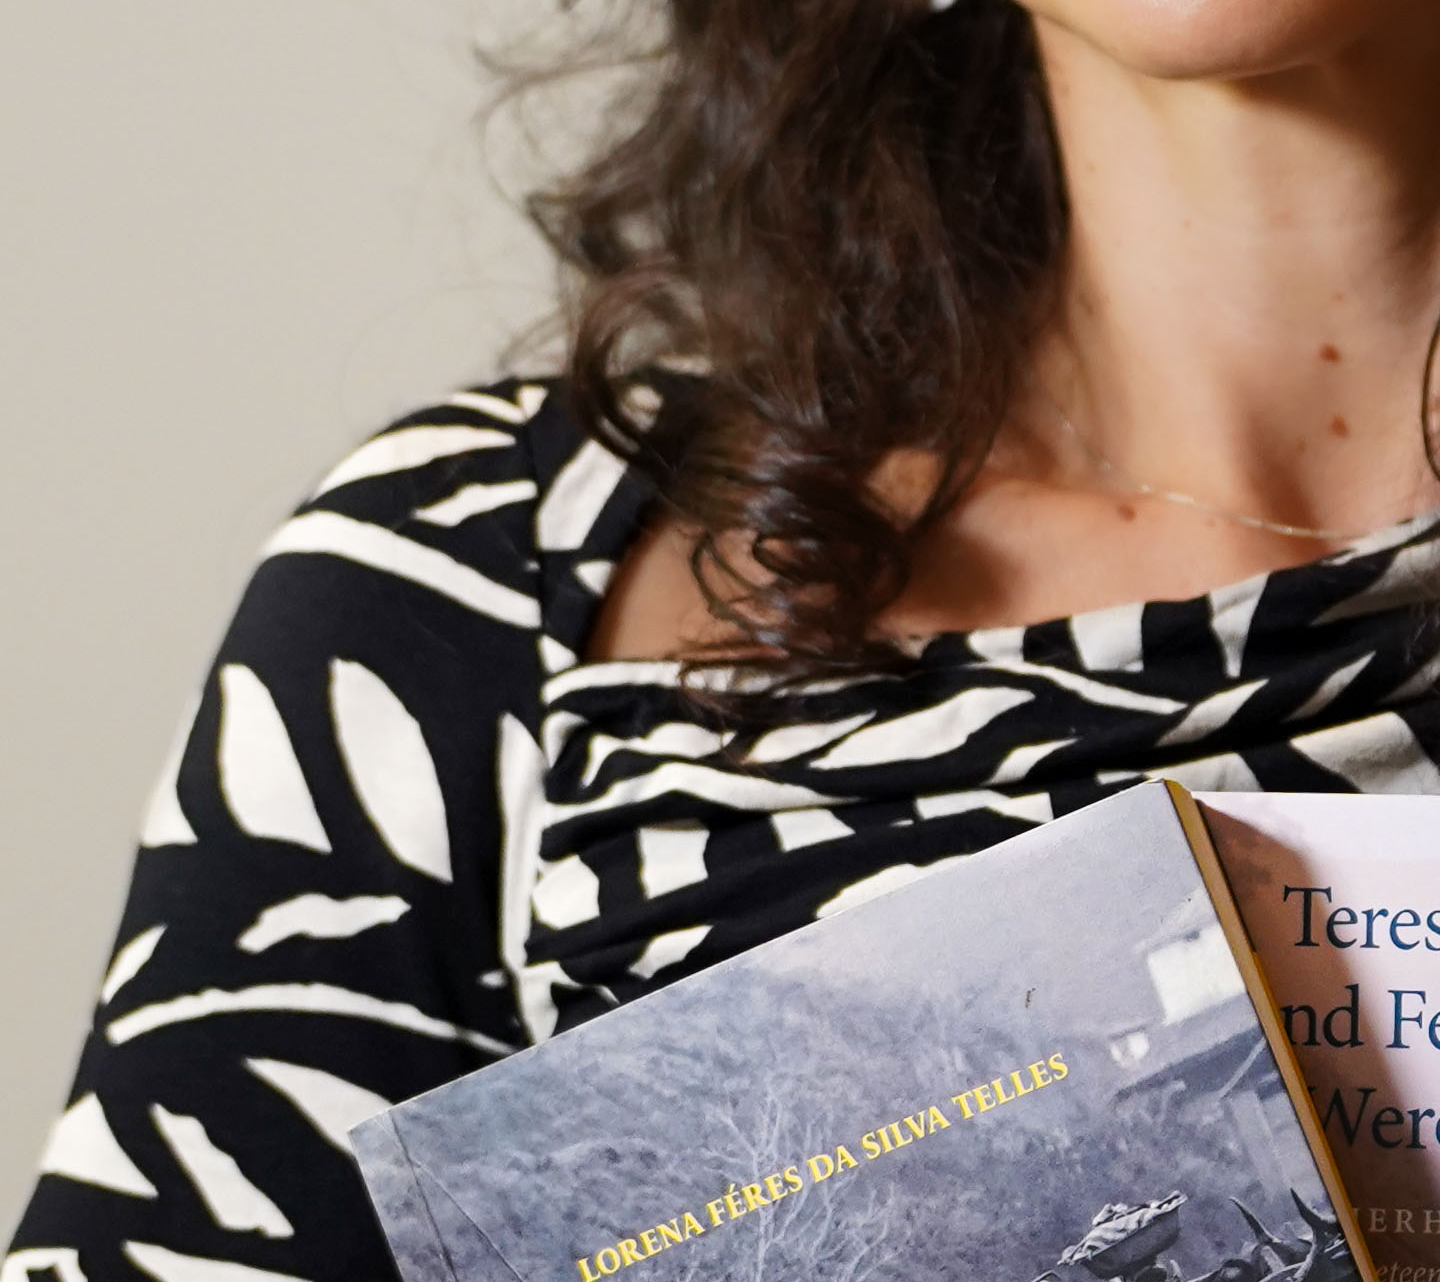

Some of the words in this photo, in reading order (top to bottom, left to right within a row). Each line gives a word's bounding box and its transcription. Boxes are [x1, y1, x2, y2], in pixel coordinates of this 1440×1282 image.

[1280, 983, 1364, 1048] nd
[706, 1165, 805, 1228] FÉRES
[806, 1145, 859, 1183] DA
[860, 1105, 951, 1160] SILVA
[951, 1052, 1070, 1120] TELLES
